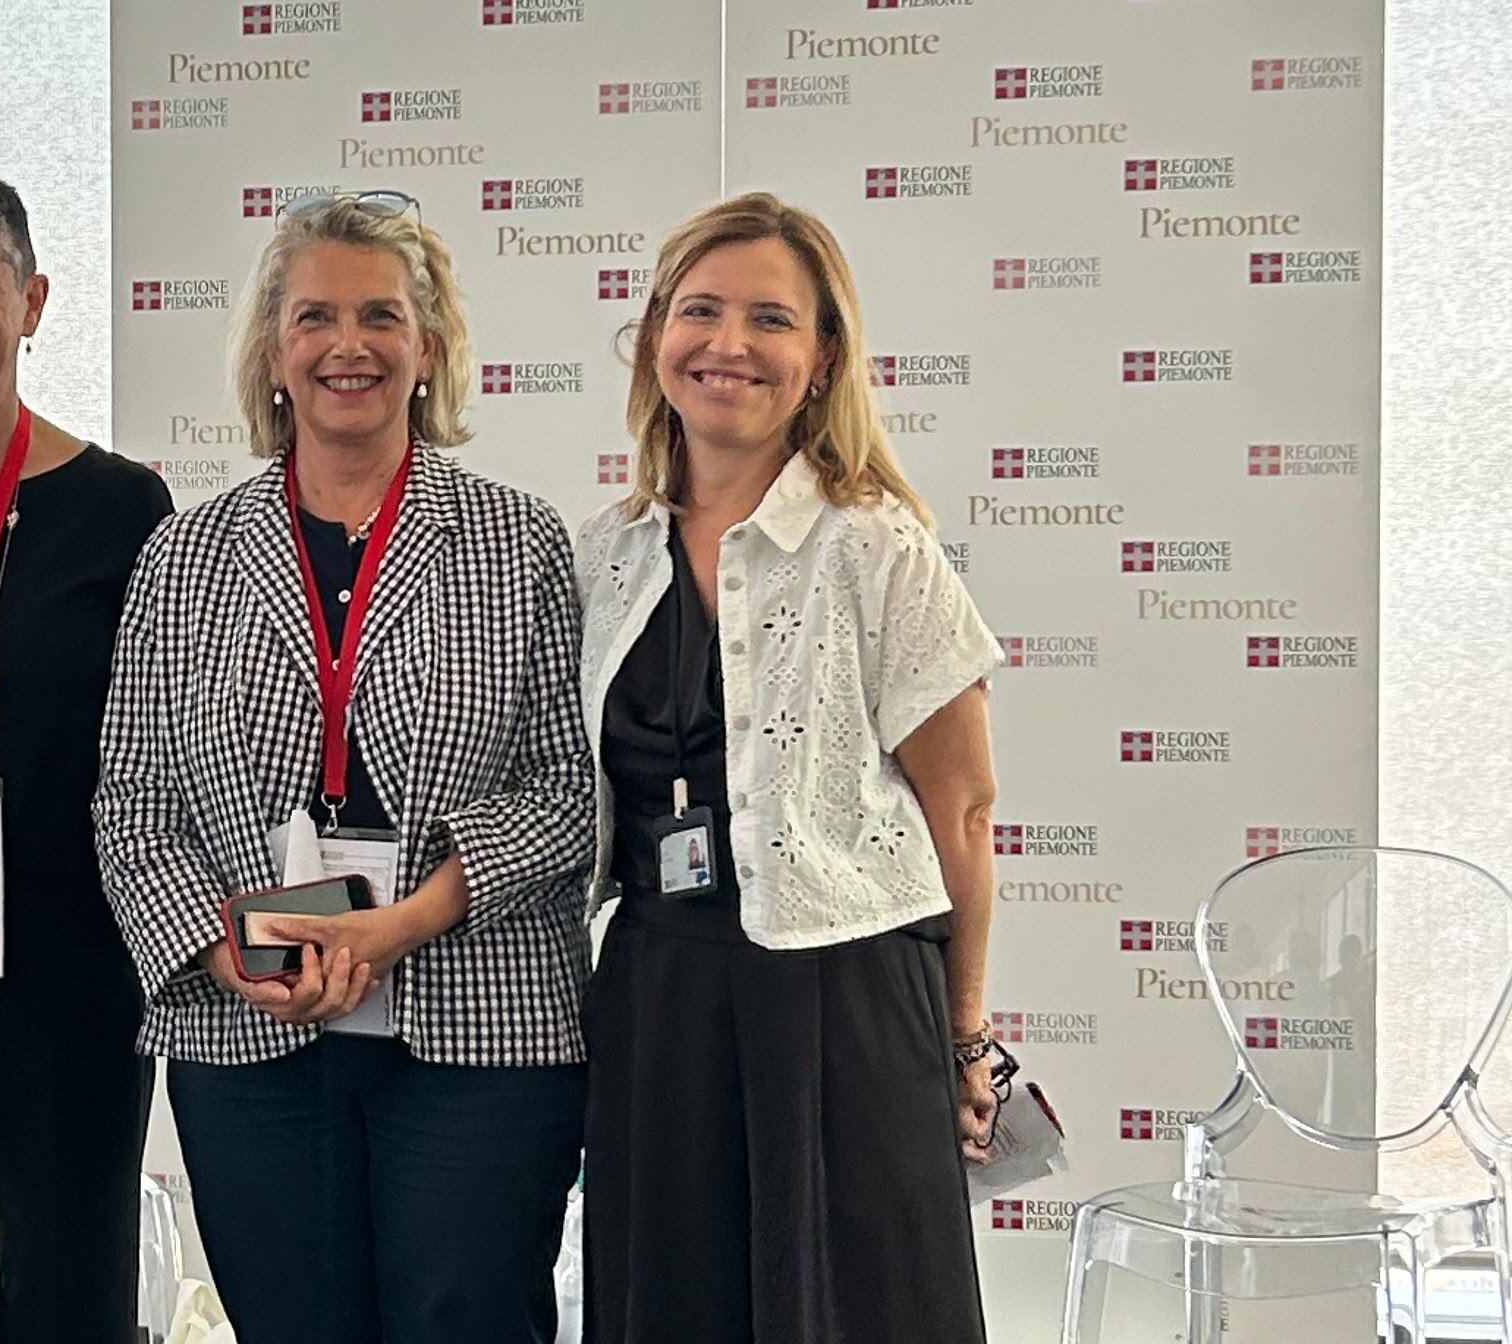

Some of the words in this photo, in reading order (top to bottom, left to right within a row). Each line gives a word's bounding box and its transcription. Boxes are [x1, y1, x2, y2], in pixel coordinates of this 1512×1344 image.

[274, 2, 341, 19] REGIONE
[515, 8, 584, 24] PIEMONTE
[274, 17, 341, 34] PIEMONTE
[785, 28, 940, 60] Piemonte
[168, 53, 311, 84] Piemonte
[1287, 57, 1363, 75] REGIONE
[780, 74, 851, 92] REGIONE
[1029, 66, 1103, 84] REGIONE
[1287, 73, 1363, 90] PIEMONTE
[632, 81, 702, 99] REGIONE
[1029, 82, 1103, 99] PIEMONTE
[393, 90, 462, 107] REGIONE
[632, 97, 702, 113] PIEMONTE
[780, 90, 851, 107] PIEMONTE
[163, 99, 228, 115] REGIONE
[393, 106, 462, 121] PIEMONTE
[163, 113, 228, 129] PIEMONTE
[971, 115, 1128, 148] Piemonte
[340, 139, 485, 169] Piemonte
[899, 165, 972, 182] REGIONE
[1159, 157, 1235, 175] REGIONE
[515, 179, 583, 196] REGIONE
[899, 181, 972, 197] PIEMONTE
[1159, 173, 1235, 190] PIEMONTE
[515, 195, 583, 210] PIEMONTE
[1139, 206, 1300, 239] Piemonte
[496, 227, 645, 256] Piemonte
[1027, 257, 1101, 275] REGIONE
[1284, 251, 1360, 269] REGIONE
[1027, 273, 1101, 289] PIEMONTE
[1284, 267, 1360, 283] PIEMONTE
[163, 280, 229, 297] REGIONE
[163, 296, 229, 310] PIEMONTE
[898, 354, 971, 371] REGIONE
[1158, 349, 1234, 367] REGIONE
[514, 363, 583, 380] REGIONE
[898, 370, 971, 386] PIEMONTE
[1158, 365, 1234, 382] PIEMONTE
[514, 379, 583, 394] PIEMONTE
[170, 416, 247, 445] Piem
[1027, 447, 1099, 463] REGIONE
[1284, 444, 1359, 460] REGIONE
[165, 461, 230, 476] REGIONE
[1027, 463, 1099, 479] PIEMONTE
[1284, 460, 1359, 476] PIEMONTE
[165, 476, 230, 489] PIEMONTE
[968, 495, 1125, 527] Piemonte
[1156, 542, 1232, 558] REGIONE
[1156, 558, 1232, 573] PIEMONTE
[1137, 589, 1297, 621] Piemonte
[1026, 637, 1098, 653] REGIONE
[1283, 637, 1358, 653] REGIONE
[1026, 653, 1098, 667] PIEMONTE
[1283, 652, 1358, 668] PIEMONTE
[1156, 732, 1231, 748] REGIONE
[1156, 747, 1231, 762] PIEMONTE
[1025, 825, 1098, 841] REGIONE
[1281, 828, 1356, 844] REGIONE
[1025, 841, 1098, 856] PIEMONTE
[998, 879, 1124, 904] emonte
[1155, 921, 1229, 937] REGINE
[1025, 1013, 1097, 1029] REGIONE
[1280, 1018, 1353, 1034] REGIONE
[1025, 1028, 1097, 1044] PIEMONTE
[1280, 1034, 1353, 1050] PIEMONTE
